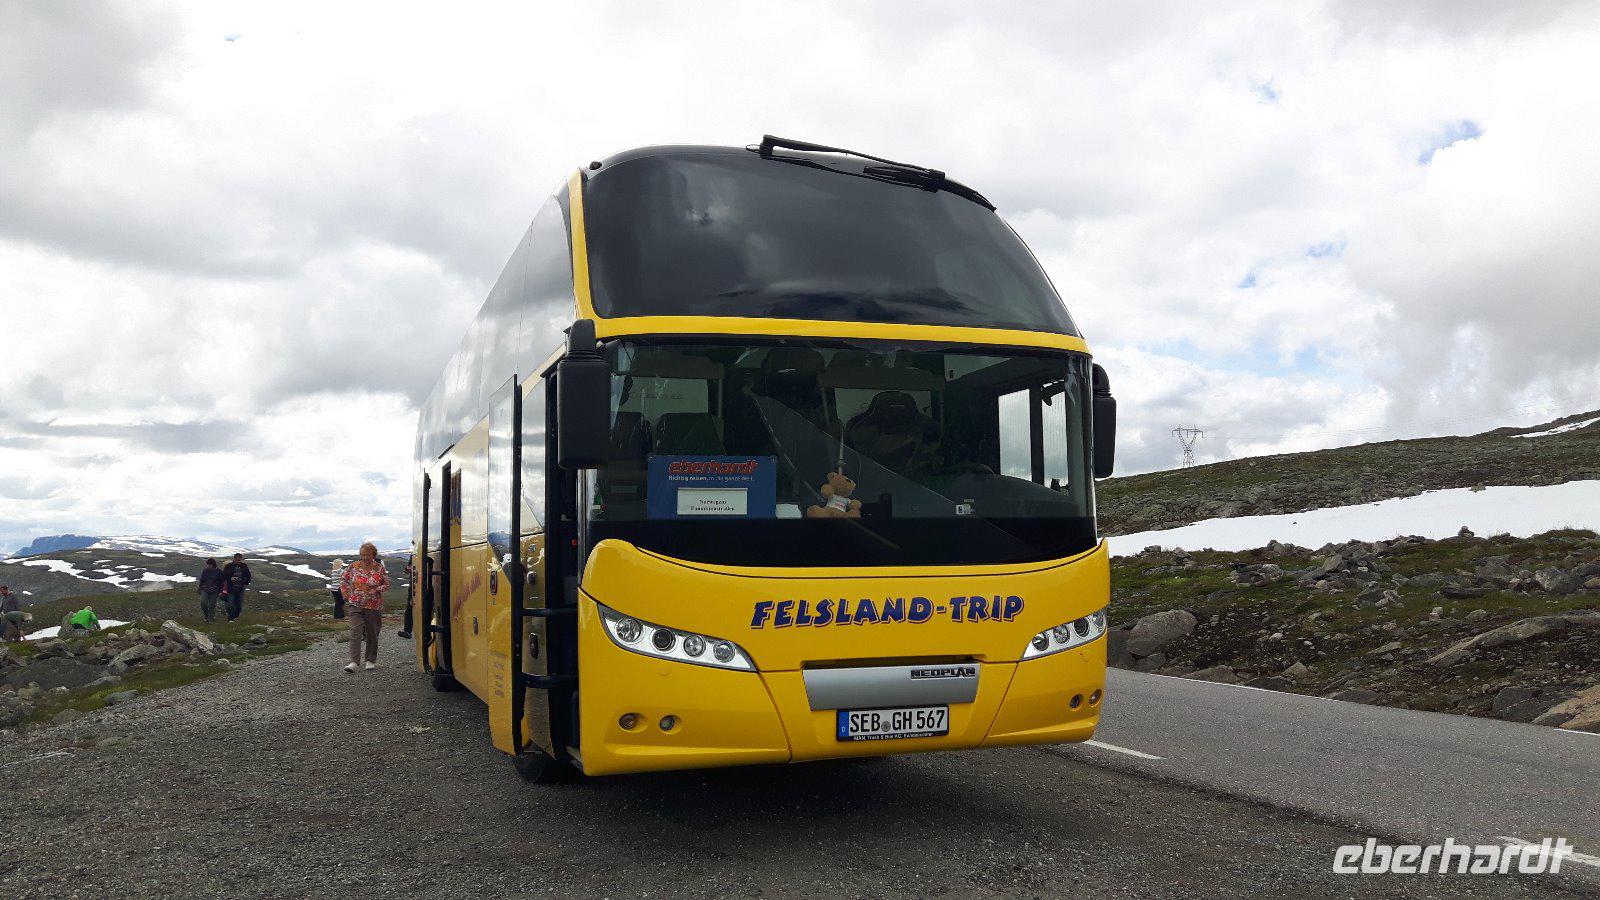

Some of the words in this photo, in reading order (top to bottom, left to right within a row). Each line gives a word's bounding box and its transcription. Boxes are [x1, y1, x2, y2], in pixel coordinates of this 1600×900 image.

[750, 595, 1025, 630] FELSLAND-TRIP
[910, 667, 976, 680] NEOPLAN
[849, 713, 881, 733] SEB
[892, 711, 913, 731] GH
[916, 709, 946, 730] 567
